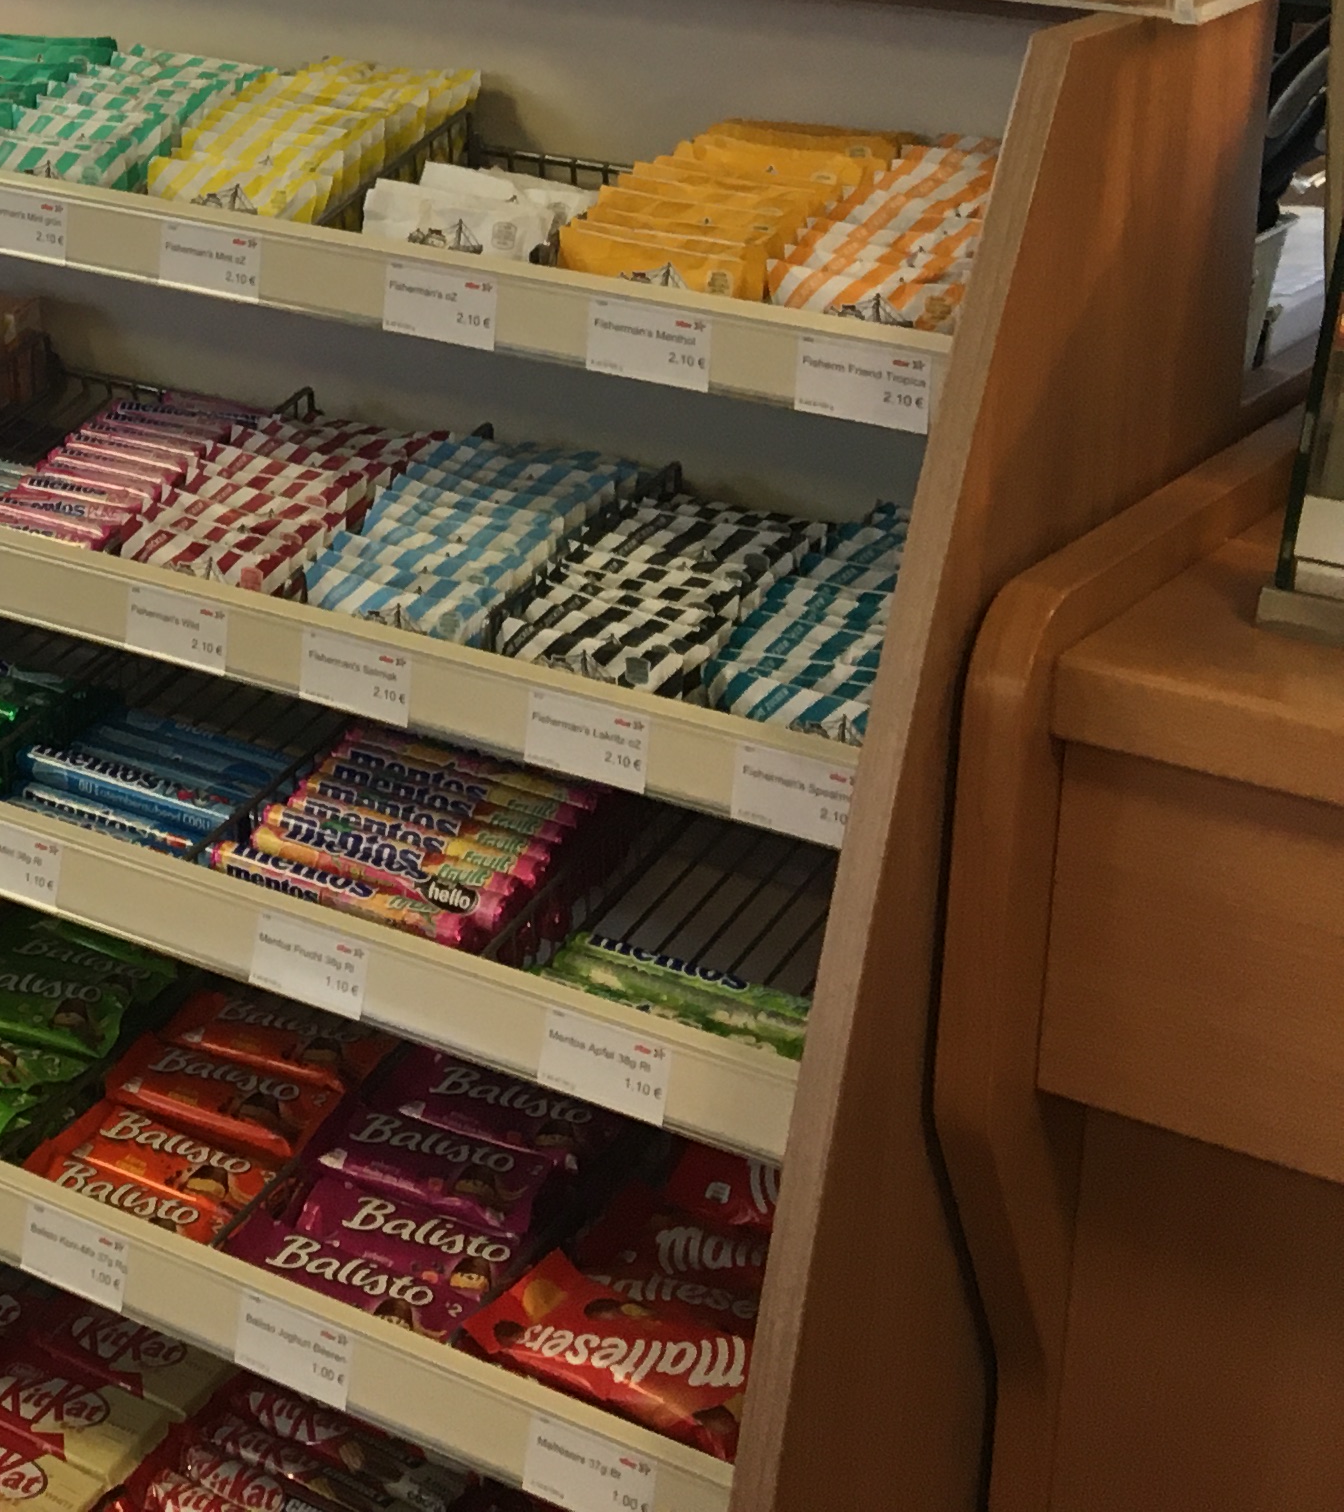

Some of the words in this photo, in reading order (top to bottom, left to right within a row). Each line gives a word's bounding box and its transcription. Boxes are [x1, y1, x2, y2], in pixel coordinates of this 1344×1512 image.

[456, 312, 480, 327] 2.10
[667, 352, 694, 367] 2.10
[604, 752, 630, 768] 2.10
[427, 884, 473, 910] hello
[100, 1111, 251, 1174] Balisto
[55, 1161, 200, 1226] Balisto
[342, 1197, 511, 1264] Balisto
[266, 1234, 435, 1308] Balisto
